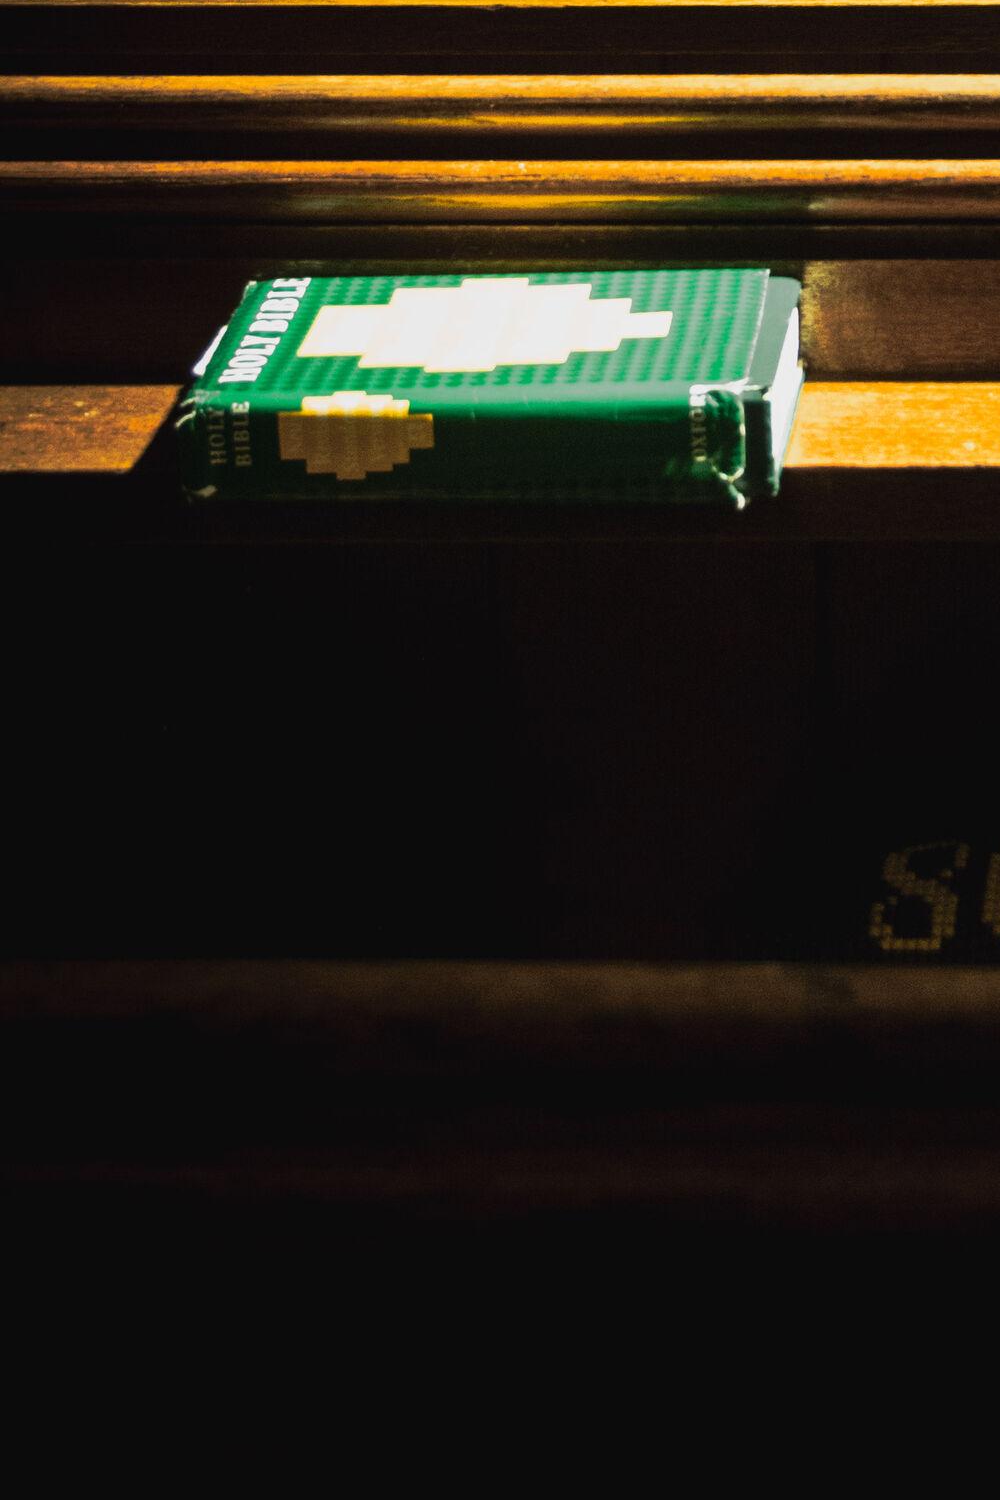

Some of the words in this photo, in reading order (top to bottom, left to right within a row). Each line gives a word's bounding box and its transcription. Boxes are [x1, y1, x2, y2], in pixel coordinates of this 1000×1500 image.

[249, 277, 312, 333] BIBLE
[218, 335, 281, 384] HOLY
[207, 408, 227, 466] HOLY
[231, 401, 252, 467] BIBLE
